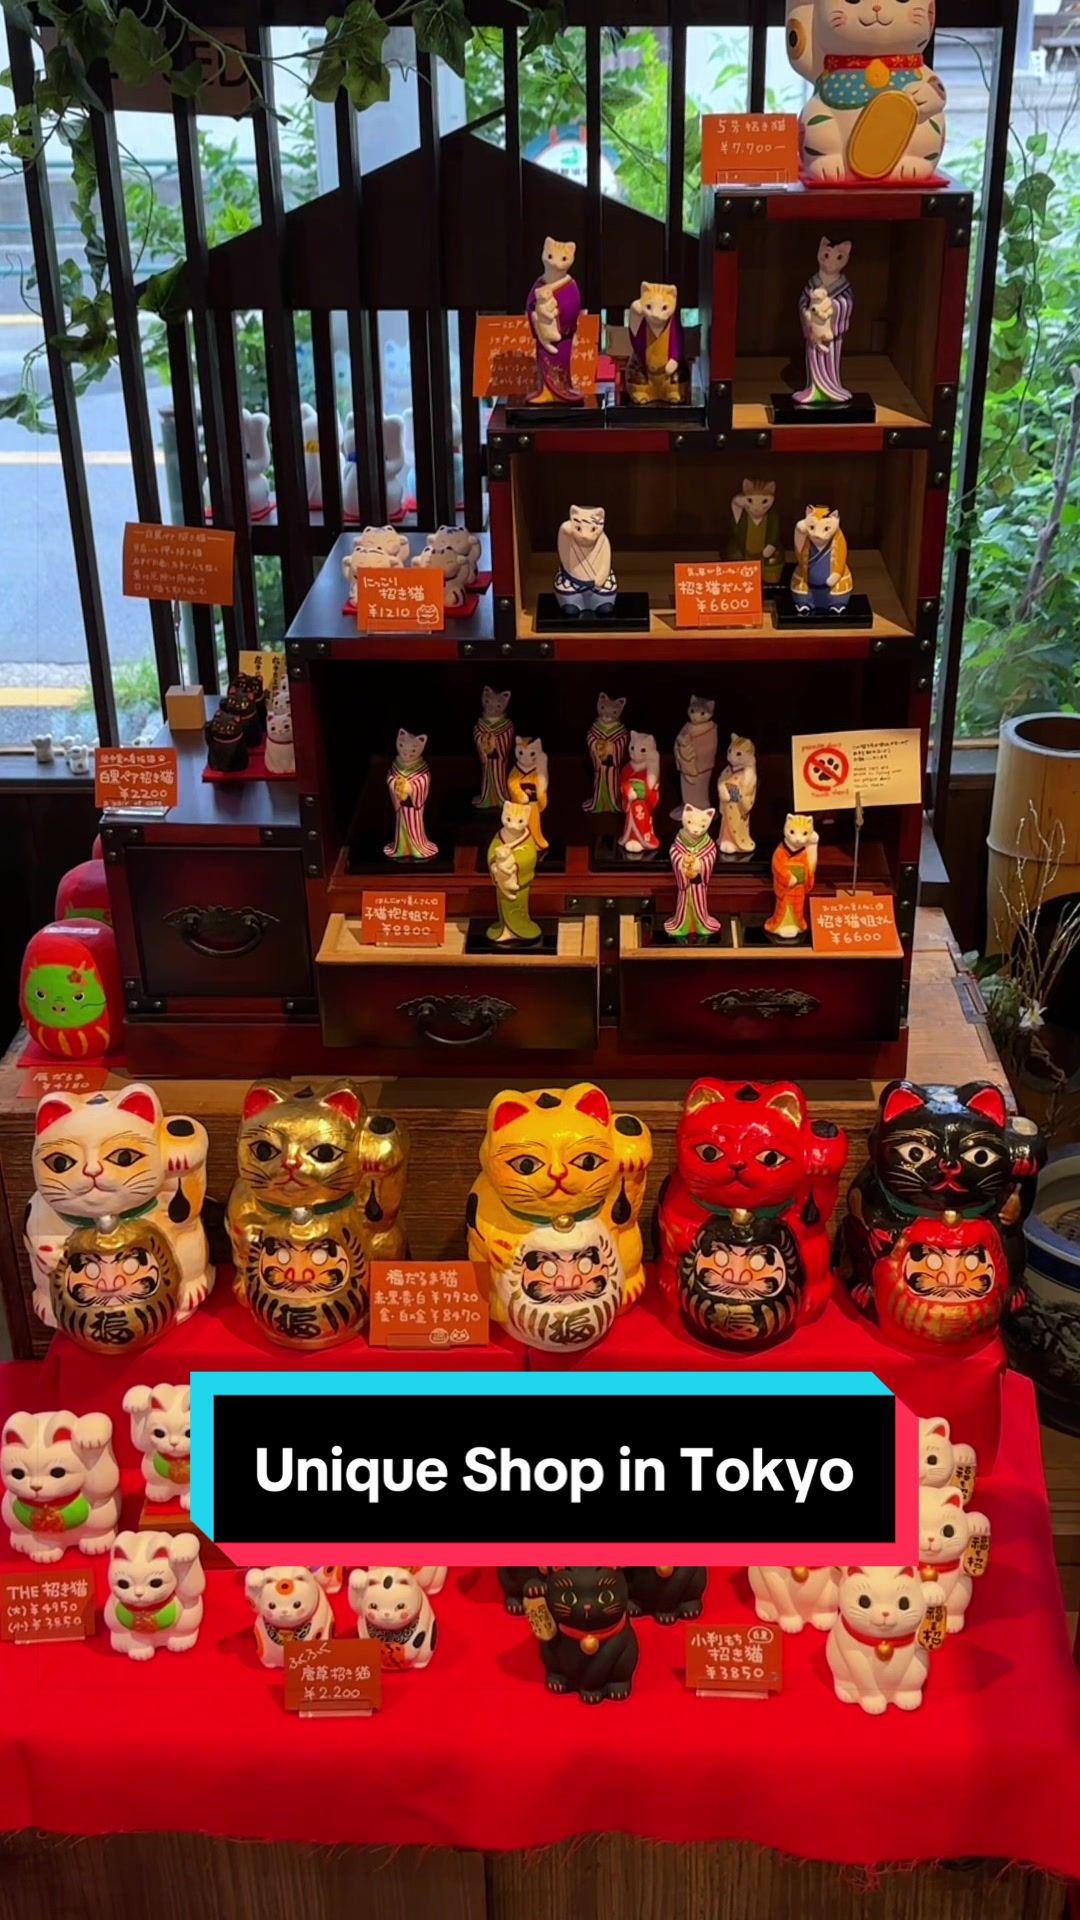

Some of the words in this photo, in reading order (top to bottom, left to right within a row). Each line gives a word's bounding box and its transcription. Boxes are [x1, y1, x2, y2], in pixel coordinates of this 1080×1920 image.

[363, 576, 398, 588] にっこり
[678, 580, 754, 596] 招き猫だんな
[379, 584, 425, 601] 招き猫
[368, 603, 410, 618] ¥1210
[696, 597, 750, 612] ¥6600
[99, 769, 175, 784] 白黒ペア招き猫
[118, 785, 168, 800] ¥2200
[381, 922, 431, 936] ¥8800
[829, 931, 881, 944] ¥6600
[385, 1269, 458, 1288] 福だるま猫
[431, 1290, 479, 1304] ¥7920
[430, 1309, 481, 1323] ¥8470
[6, 1585, 40, 1600] THE
[41, 1578, 88, 1598] 招き猫
[30, 1601, 78, 1616] ¥4950
[32, 1615, 82, 1631] ¥3850
[707, 1644, 763, 1664] 招き猫
[705, 1664, 765, 1680] ¥3850
